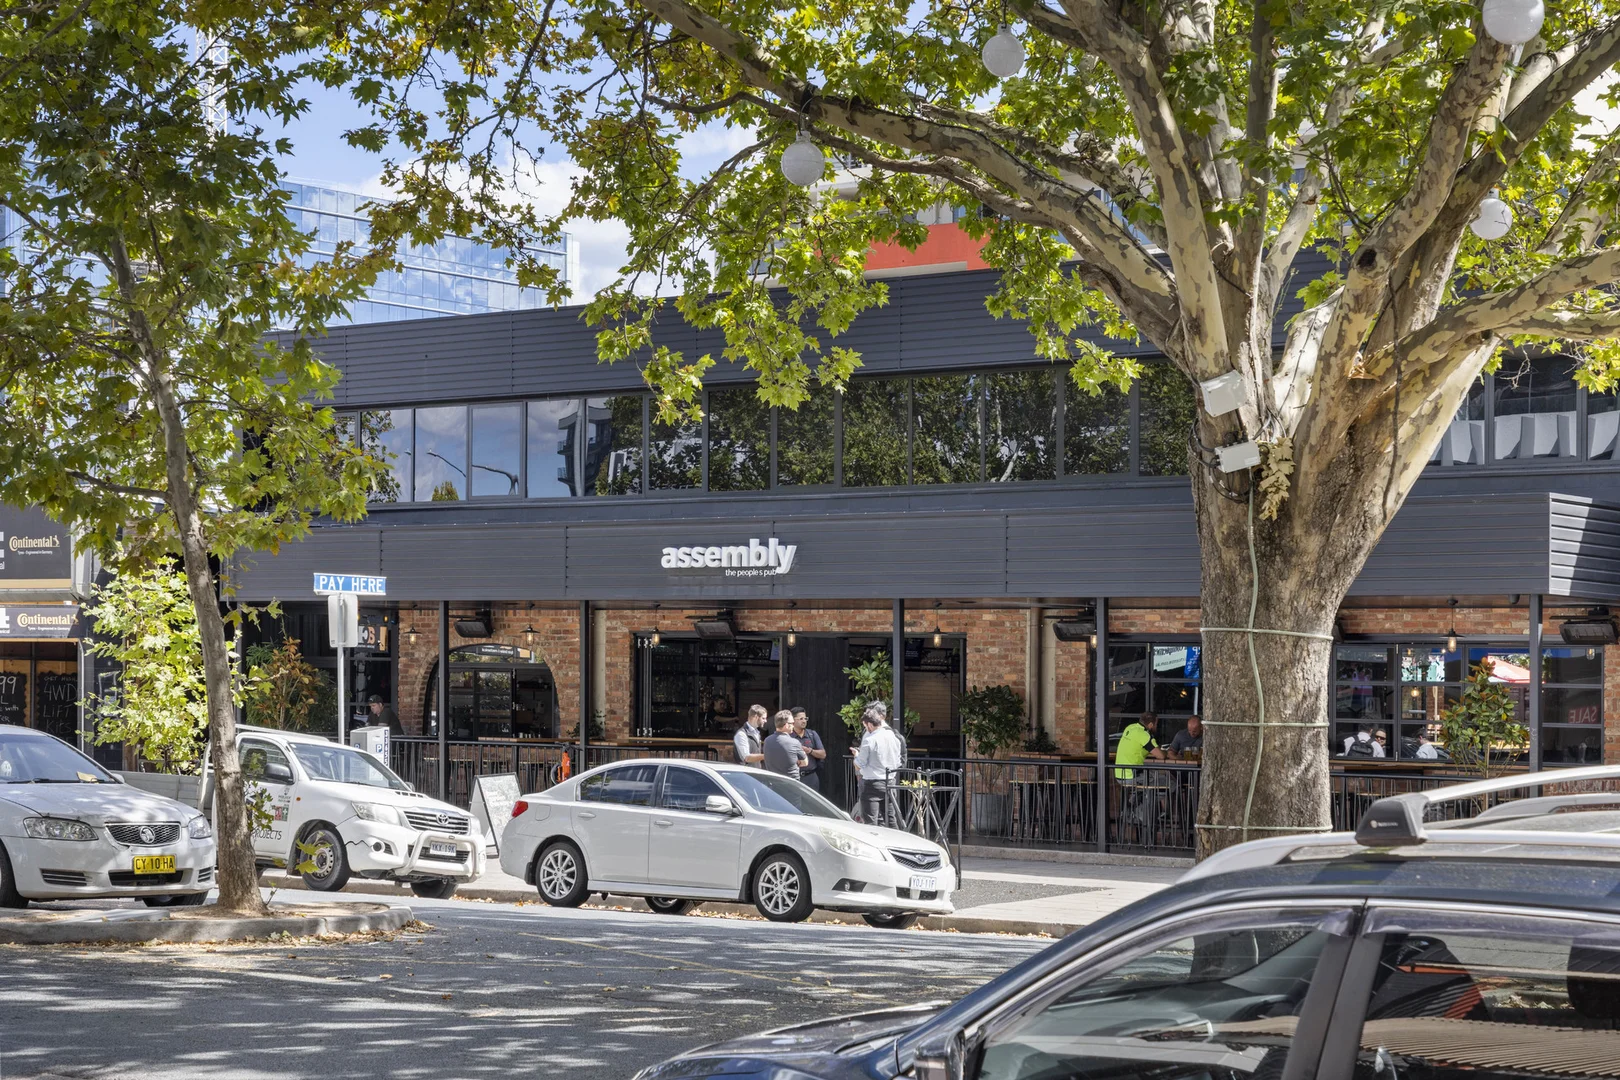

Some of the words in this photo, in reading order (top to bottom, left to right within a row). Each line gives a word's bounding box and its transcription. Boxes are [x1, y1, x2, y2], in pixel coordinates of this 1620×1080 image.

[9, 536, 53, 551] Continental
[661, 537, 797, 574] assembly
[725, 568, 737, 576] the
[763, 568, 777, 577] pub
[320, 575, 345, 591] PAY
[351, 577, 384, 592] HERE
[17, 613, 70, 627] Continental
[43, 681, 77, 701] 4WD
